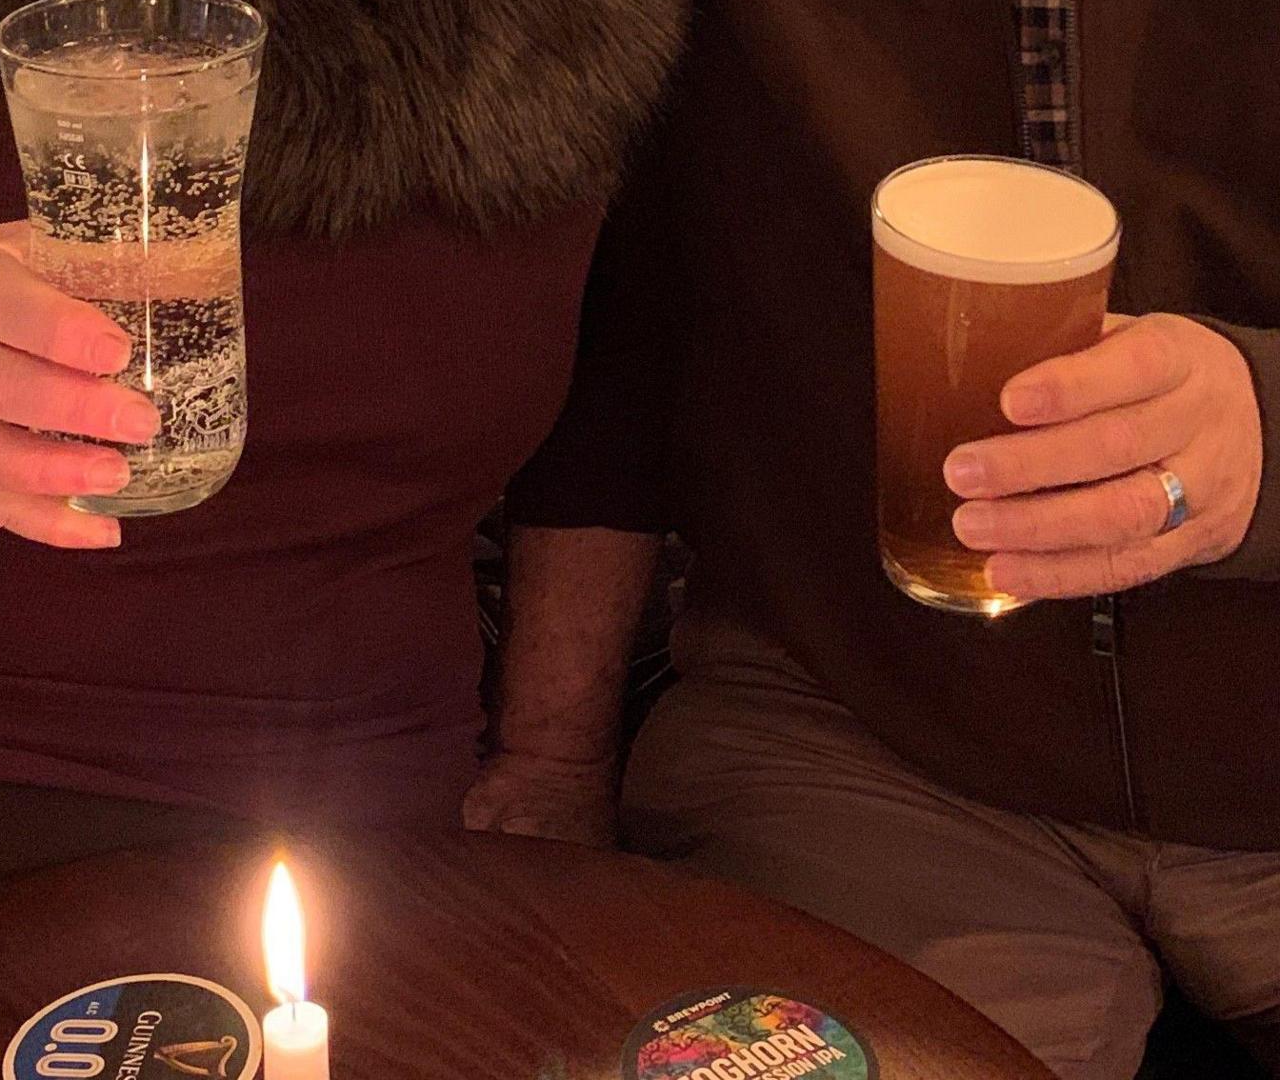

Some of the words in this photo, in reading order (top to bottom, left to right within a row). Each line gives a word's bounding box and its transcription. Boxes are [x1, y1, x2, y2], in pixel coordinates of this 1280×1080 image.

[667, 992, 732, 1023] BREWPOINT
[36, 1019, 119, 1078] 0.0
[676, 1023, 827, 1080] OGHORN
[814, 1046, 846, 1066] IPA
